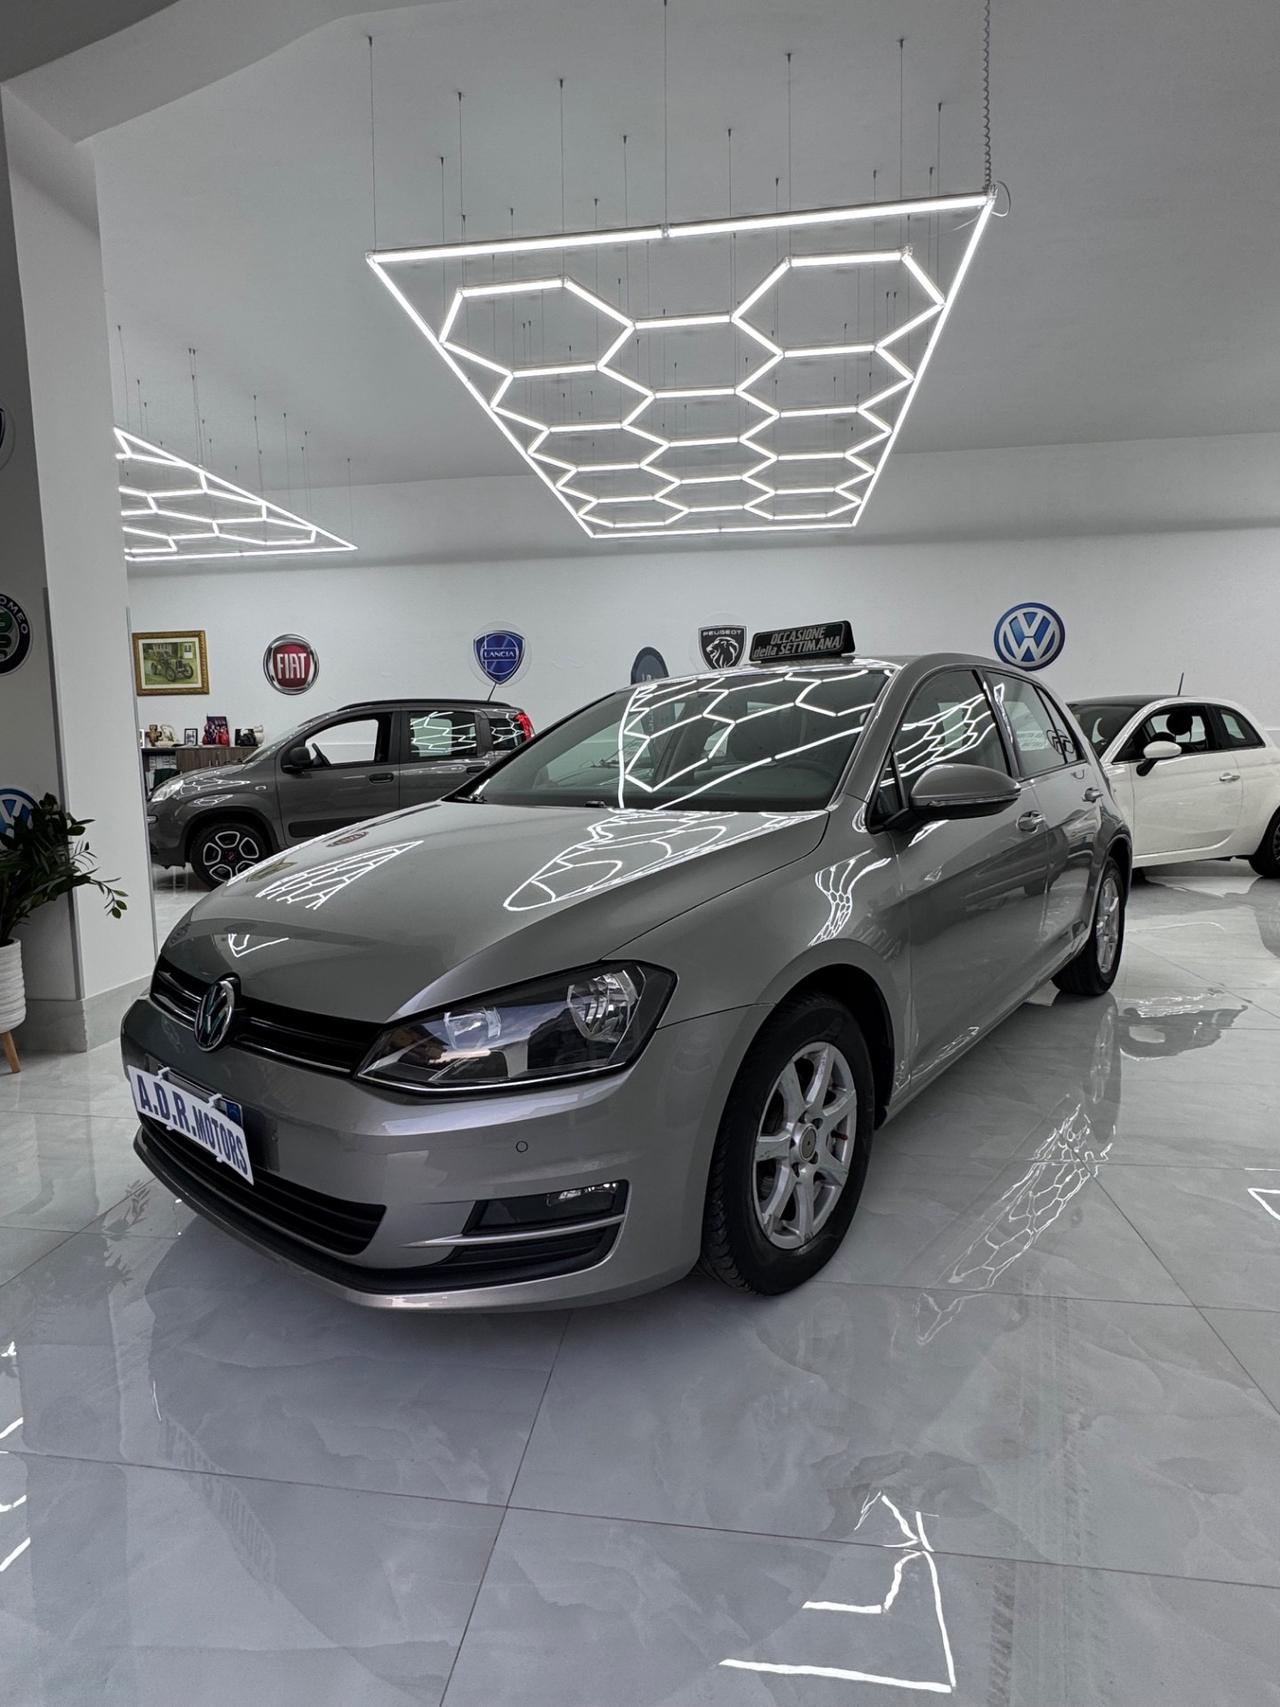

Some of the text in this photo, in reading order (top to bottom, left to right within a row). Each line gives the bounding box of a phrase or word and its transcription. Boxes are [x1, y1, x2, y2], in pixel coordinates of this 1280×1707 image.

[702, 629, 742, 637] PEUGEOT
[770, 626, 826, 645] OCCASIONE
[1000, 607, 1060, 666] VW
[753, 635, 842, 658] della SETTIMANA
[276, 653, 307, 680] FIAT
